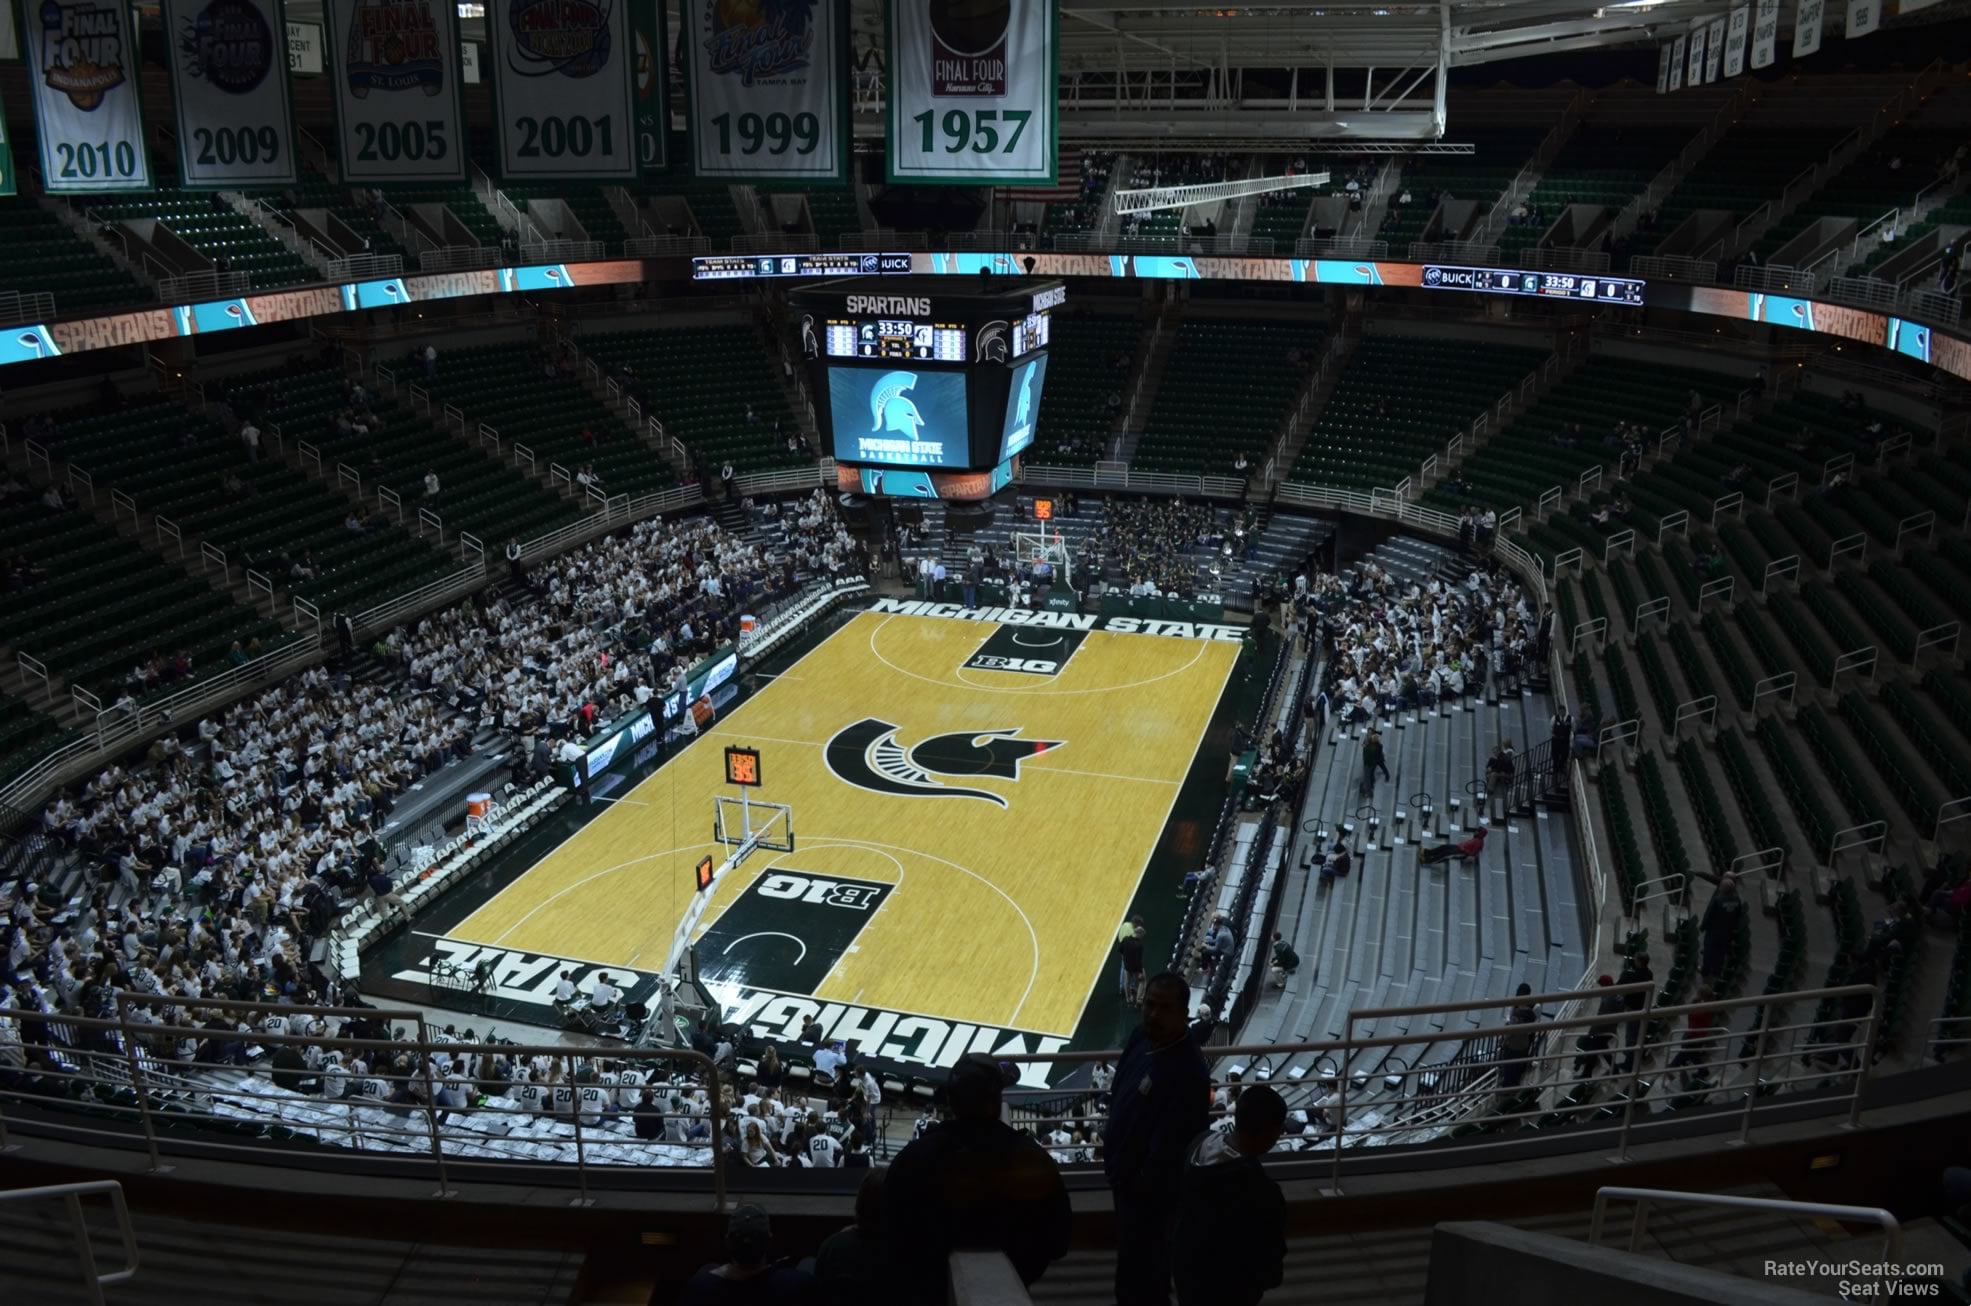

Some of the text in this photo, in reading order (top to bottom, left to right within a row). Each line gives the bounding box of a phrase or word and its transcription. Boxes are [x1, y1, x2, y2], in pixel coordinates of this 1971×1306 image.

[61, 8, 118, 36] FINAL
[360, 4, 433, 36] FINAL
[44, 29, 120, 71] FOUR
[935, 58, 1005, 82] FINAL FOUR
[515, 115, 613, 157] 2001
[711, 112, 820, 155] 1999
[913, 109, 1033, 154] 1957
[193, 126, 279, 165] 2009
[354, 121, 447, 161] 2005
[56, 141, 136, 178] 2010
[1016, 254, 1111, 276] SPARTANS
[1197, 258, 1292, 281] SPARTANS
[407, 270, 496, 301] SPARTANS
[1442, 272, 1472, 285] BUICK
[1502, 275, 1510, 288] 0
[1545, 276, 1574, 289] 33:50
[1607, 284, 1615, 297] 0
[253, 287, 341, 323] SPARTANS
[846, 295, 931, 316] SPARTANS
[55, 310, 171, 353] SPARTANS
[878, 322, 913, 335] 33:50
[1814, 304, 1888, 343] SPARTANS
[864, 346, 872, 356] 0
[920, 347, 927, 357] 0
[911, 440, 944, 455] STATE
[860, 451, 943, 464] BASKETBALL
[870, 598, 1251, 642] MICHIGAN STATE
[267, 1018, 282, 1029] 20
[322, 1055, 338, 1068] 20
[363, 1081, 377, 1095] 20
[622, 1073, 637, 1085] 20
[522, 1087, 537, 1100] 20
[556, 1089, 572, 1102] 20
[583, 1088, 598, 1101] 20
[654, 1088, 668, 1099] 20
[813, 1139, 828, 1151] 20
